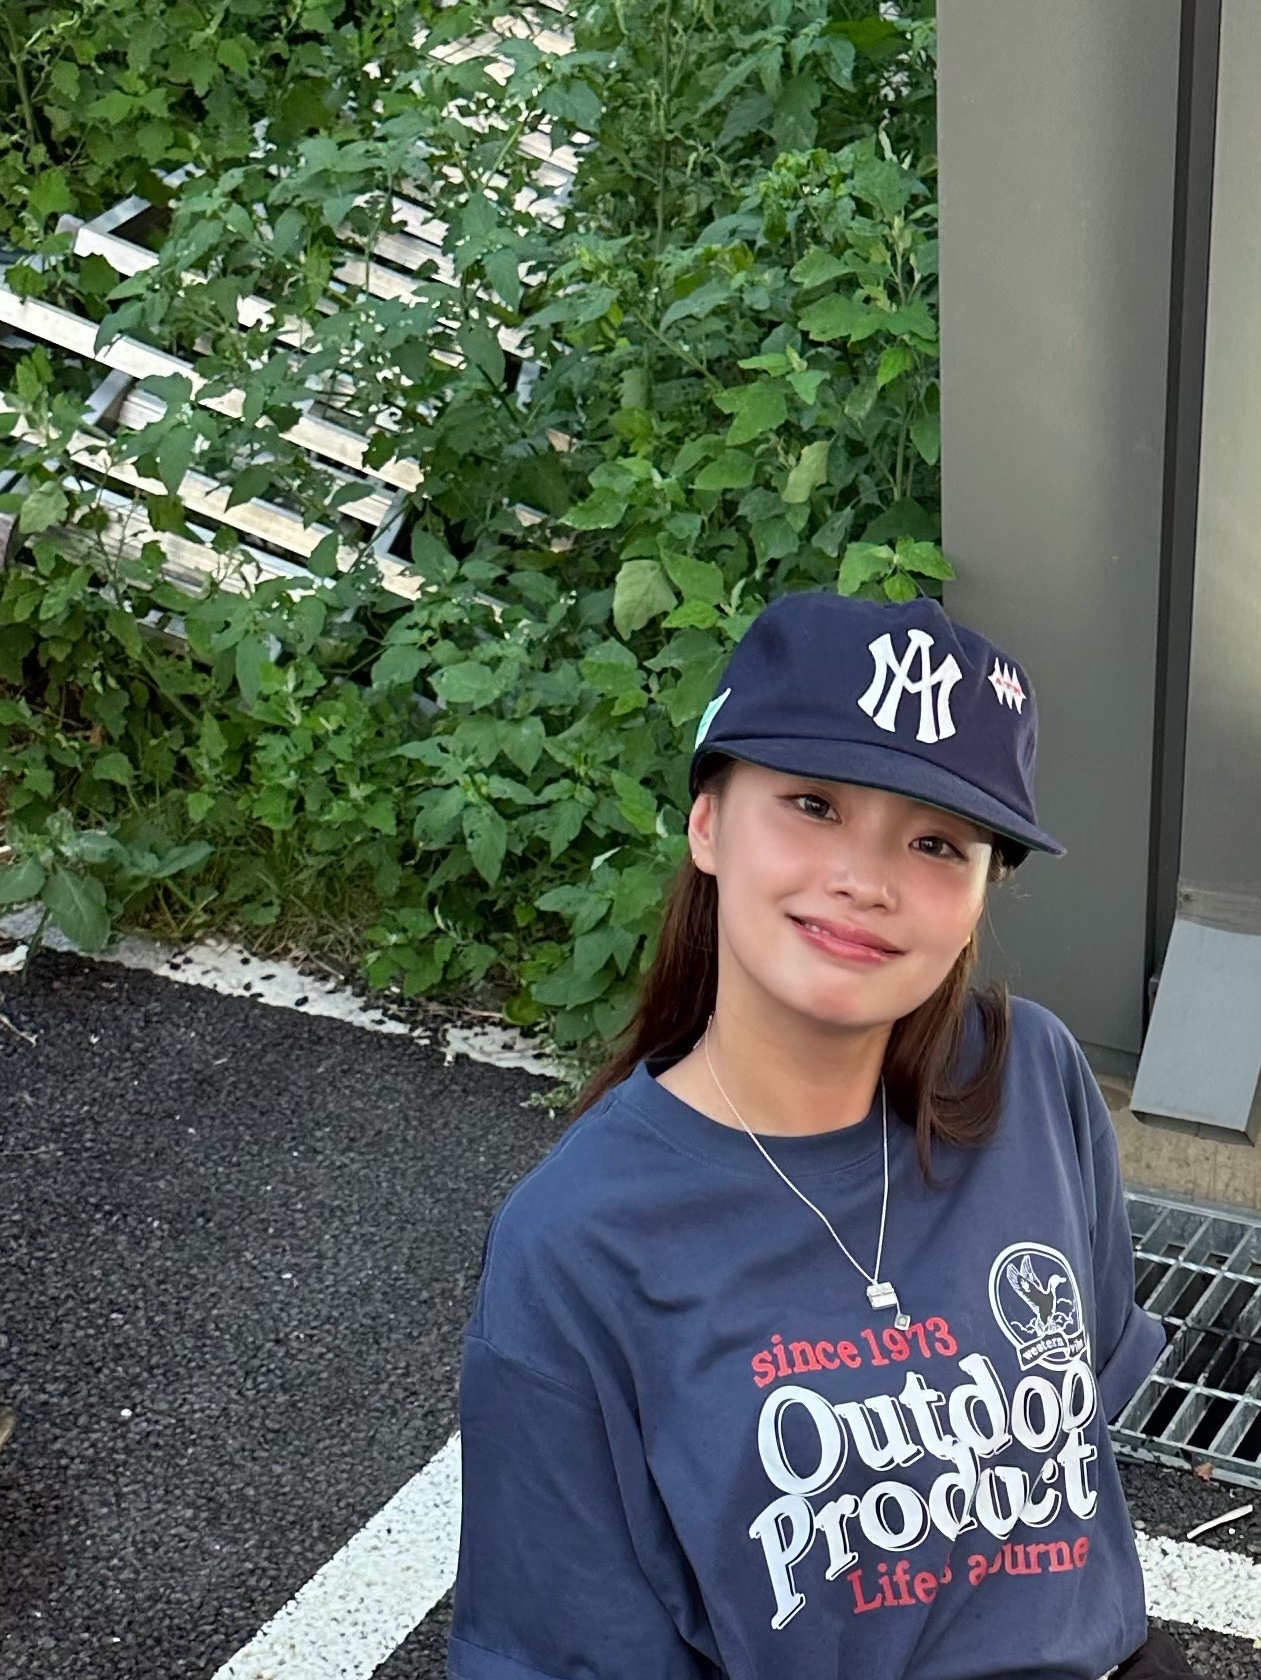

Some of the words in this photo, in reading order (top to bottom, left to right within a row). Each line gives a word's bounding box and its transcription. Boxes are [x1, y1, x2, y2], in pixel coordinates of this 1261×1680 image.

[751, 1333, 862, 1388] since
[861, 1315, 959, 1368] 1973
[1022, 1335, 1065, 1361] western
